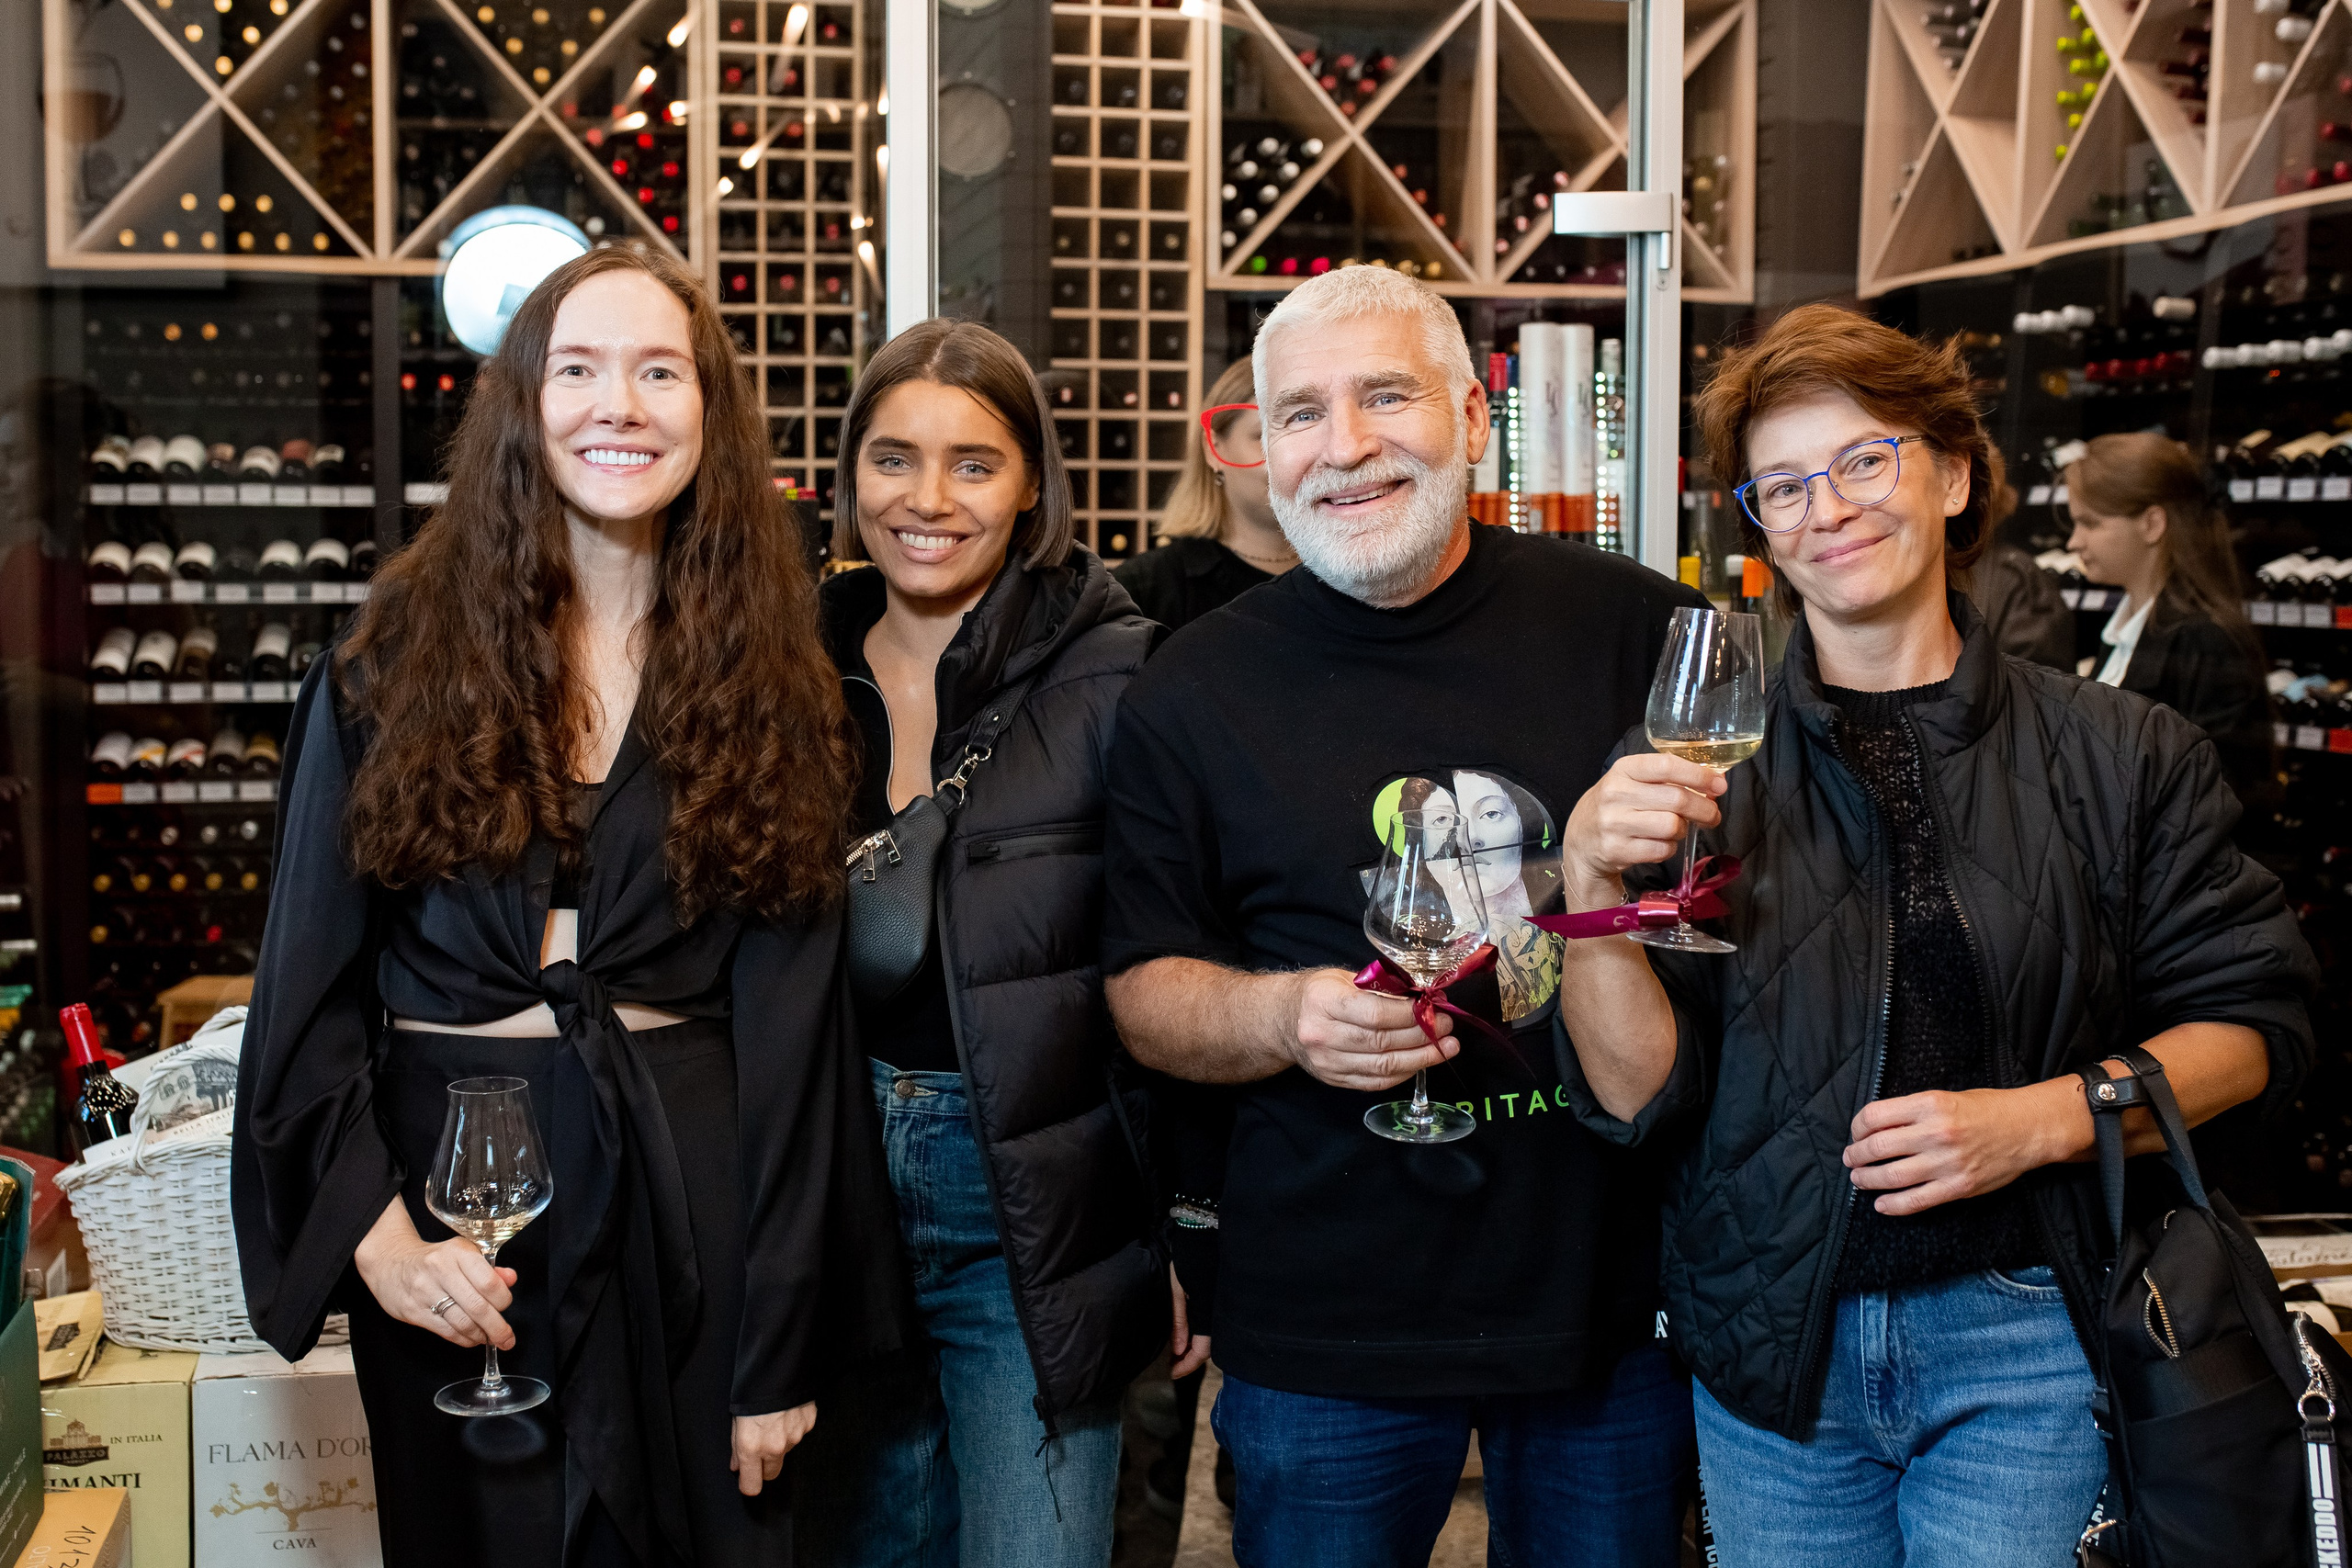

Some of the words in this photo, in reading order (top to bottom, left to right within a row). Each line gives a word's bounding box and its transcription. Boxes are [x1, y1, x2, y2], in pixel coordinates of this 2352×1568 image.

[110, 1436, 123, 1445] IN
[126, 1433, 164, 1444] ITALIA
[46, 1449, 107, 1461] PALAZZO
[209, 1440, 307, 1464] FLAMA
[43, 1472, 141, 1488] IMANTI
[273, 1537, 317, 1551] CAVA
